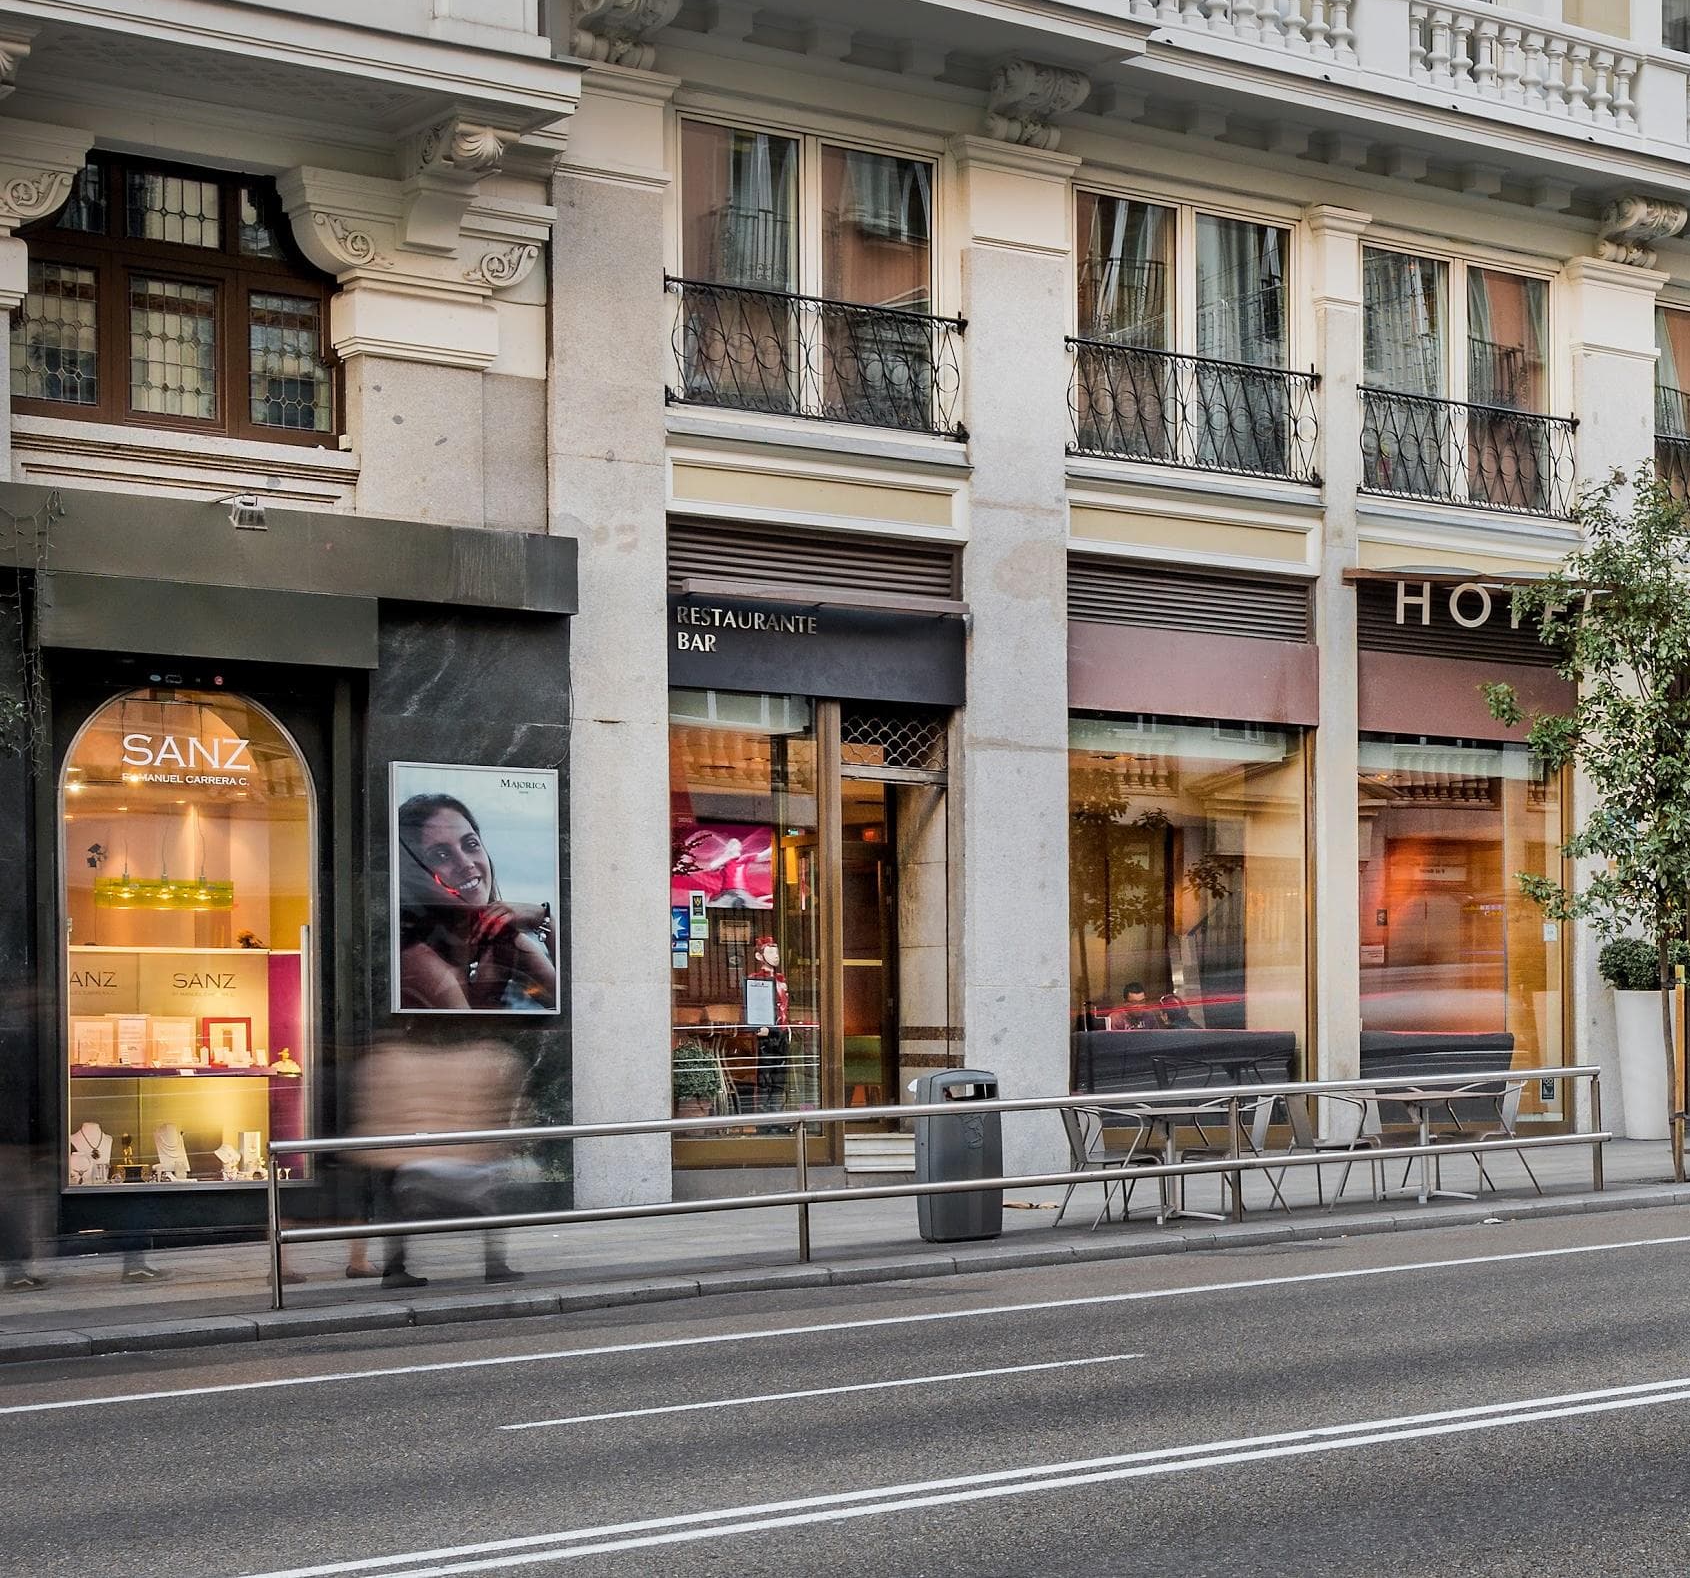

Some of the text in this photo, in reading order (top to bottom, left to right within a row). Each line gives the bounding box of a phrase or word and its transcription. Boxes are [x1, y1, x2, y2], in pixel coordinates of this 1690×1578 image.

[677, 605, 818, 635] RESTAURANTE
[677, 631, 718, 652] BAR
[122, 733, 250, 772] SANZ
[185, 775, 237, 786] CARRERA
[238, 777, 249, 786] C.
[70, 971, 237, 990] ANZ SANZ
